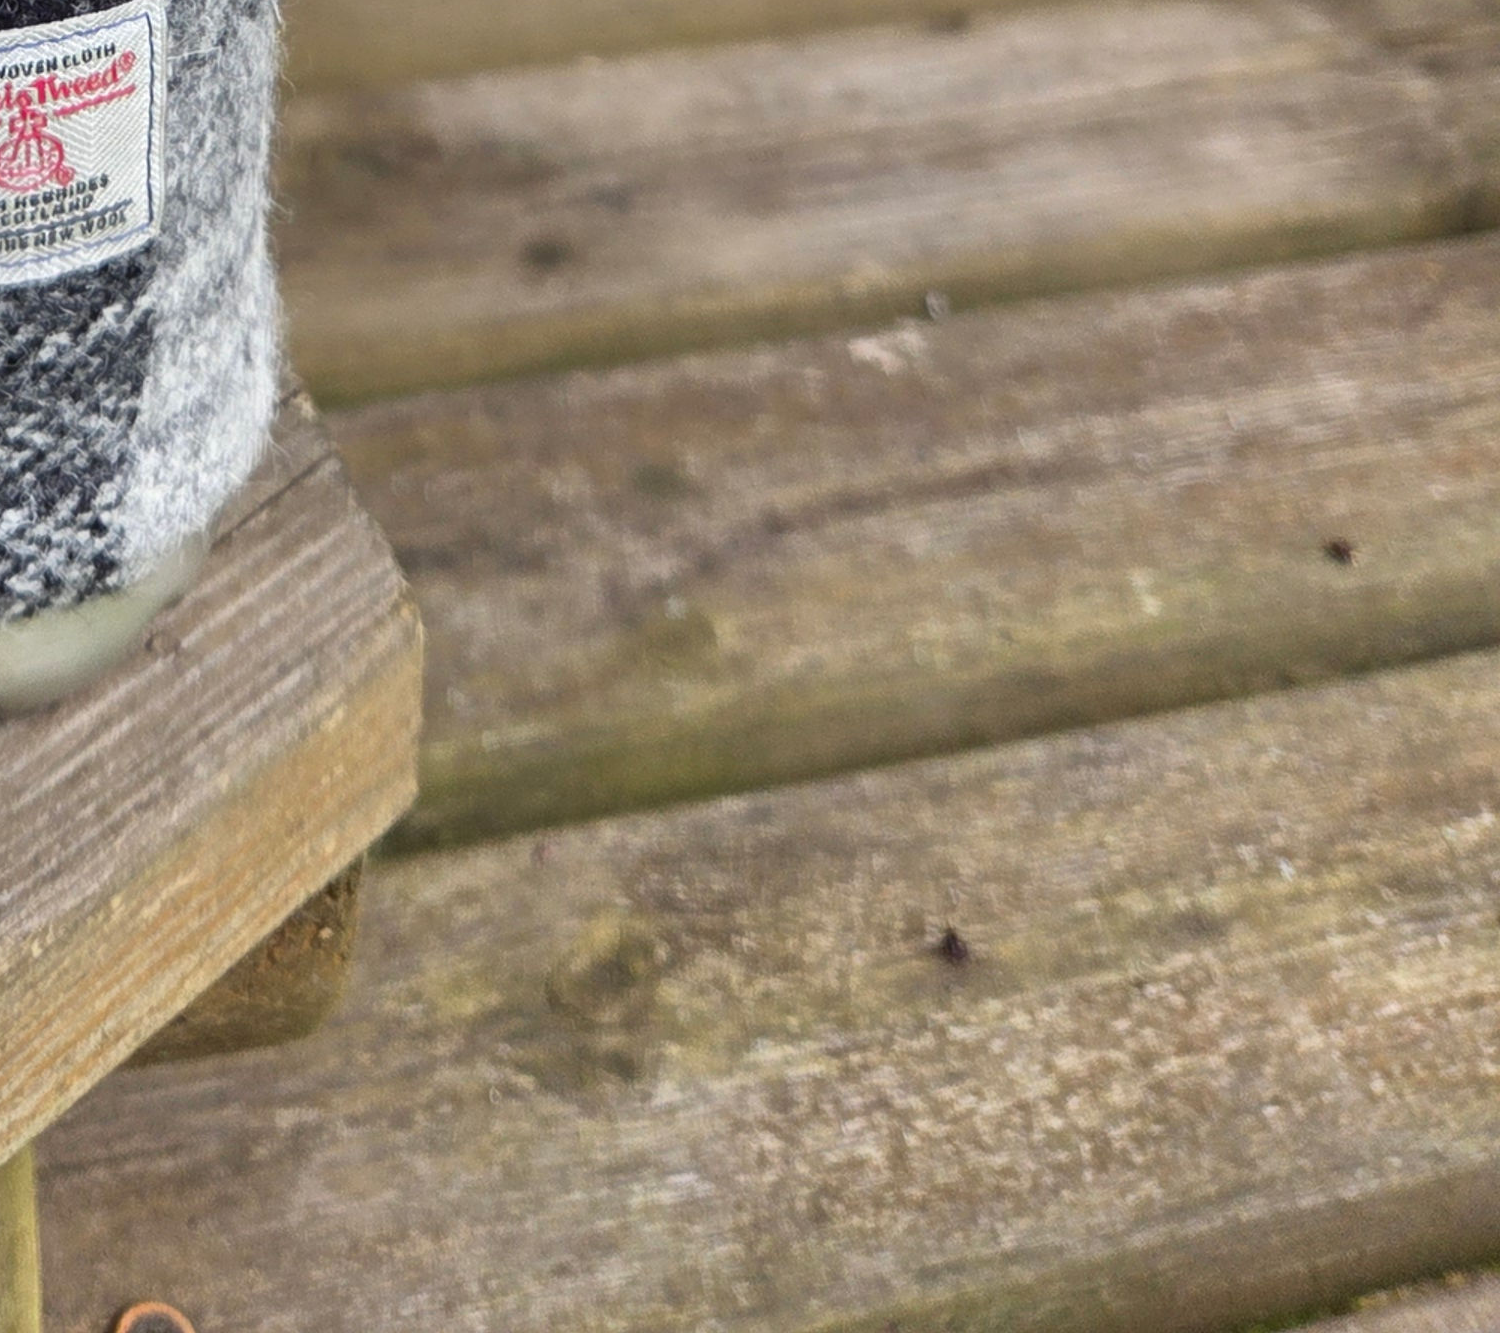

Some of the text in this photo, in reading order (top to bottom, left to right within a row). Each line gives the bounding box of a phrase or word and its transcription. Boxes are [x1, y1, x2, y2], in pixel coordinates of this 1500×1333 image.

[63, 42, 116, 67] CLOTH
[15, 173, 109, 209] HEBRIDES
[34, 228, 74, 247] NEW
[80, 210, 127, 234] WOOL
